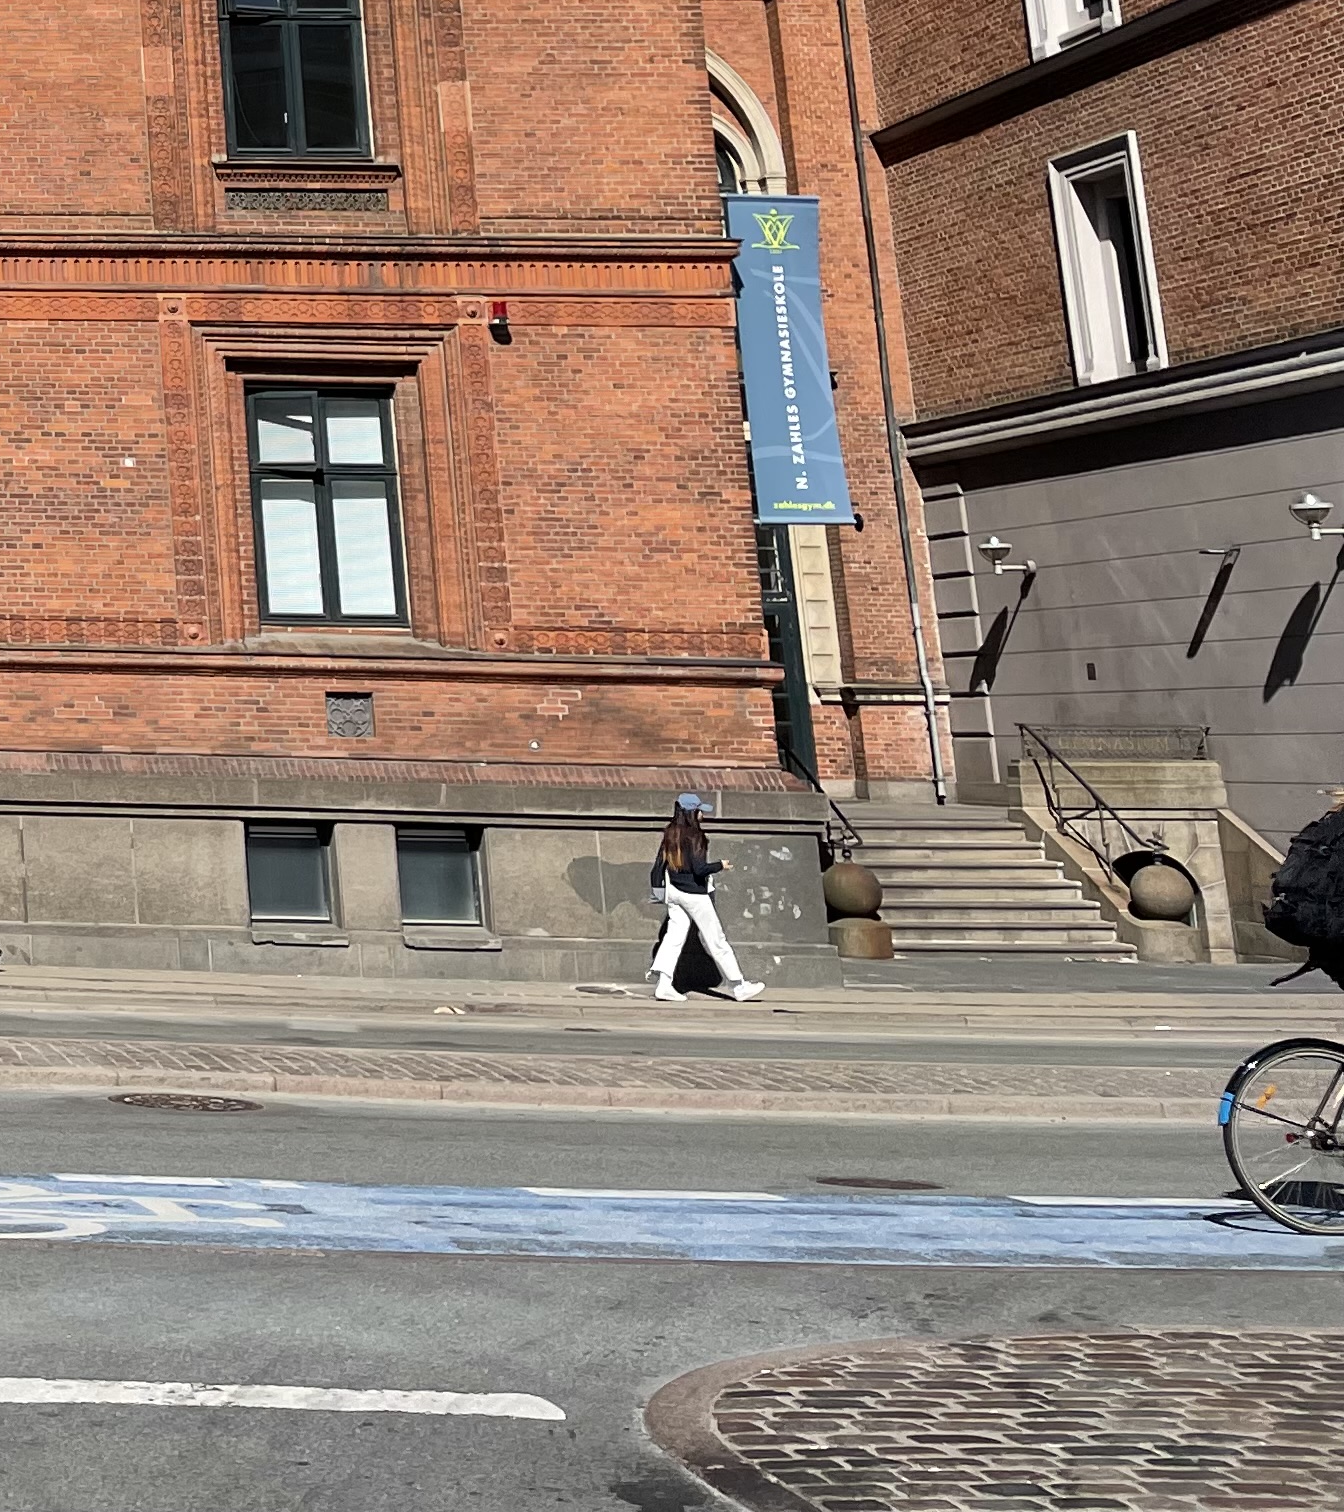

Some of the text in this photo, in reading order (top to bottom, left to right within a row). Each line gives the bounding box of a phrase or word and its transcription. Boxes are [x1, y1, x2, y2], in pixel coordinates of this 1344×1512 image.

[771, 265, 797, 399] GYMNASIESKOLE
[786, 404, 806, 464] ZAHLES
[795, 470, 809, 490] N.
